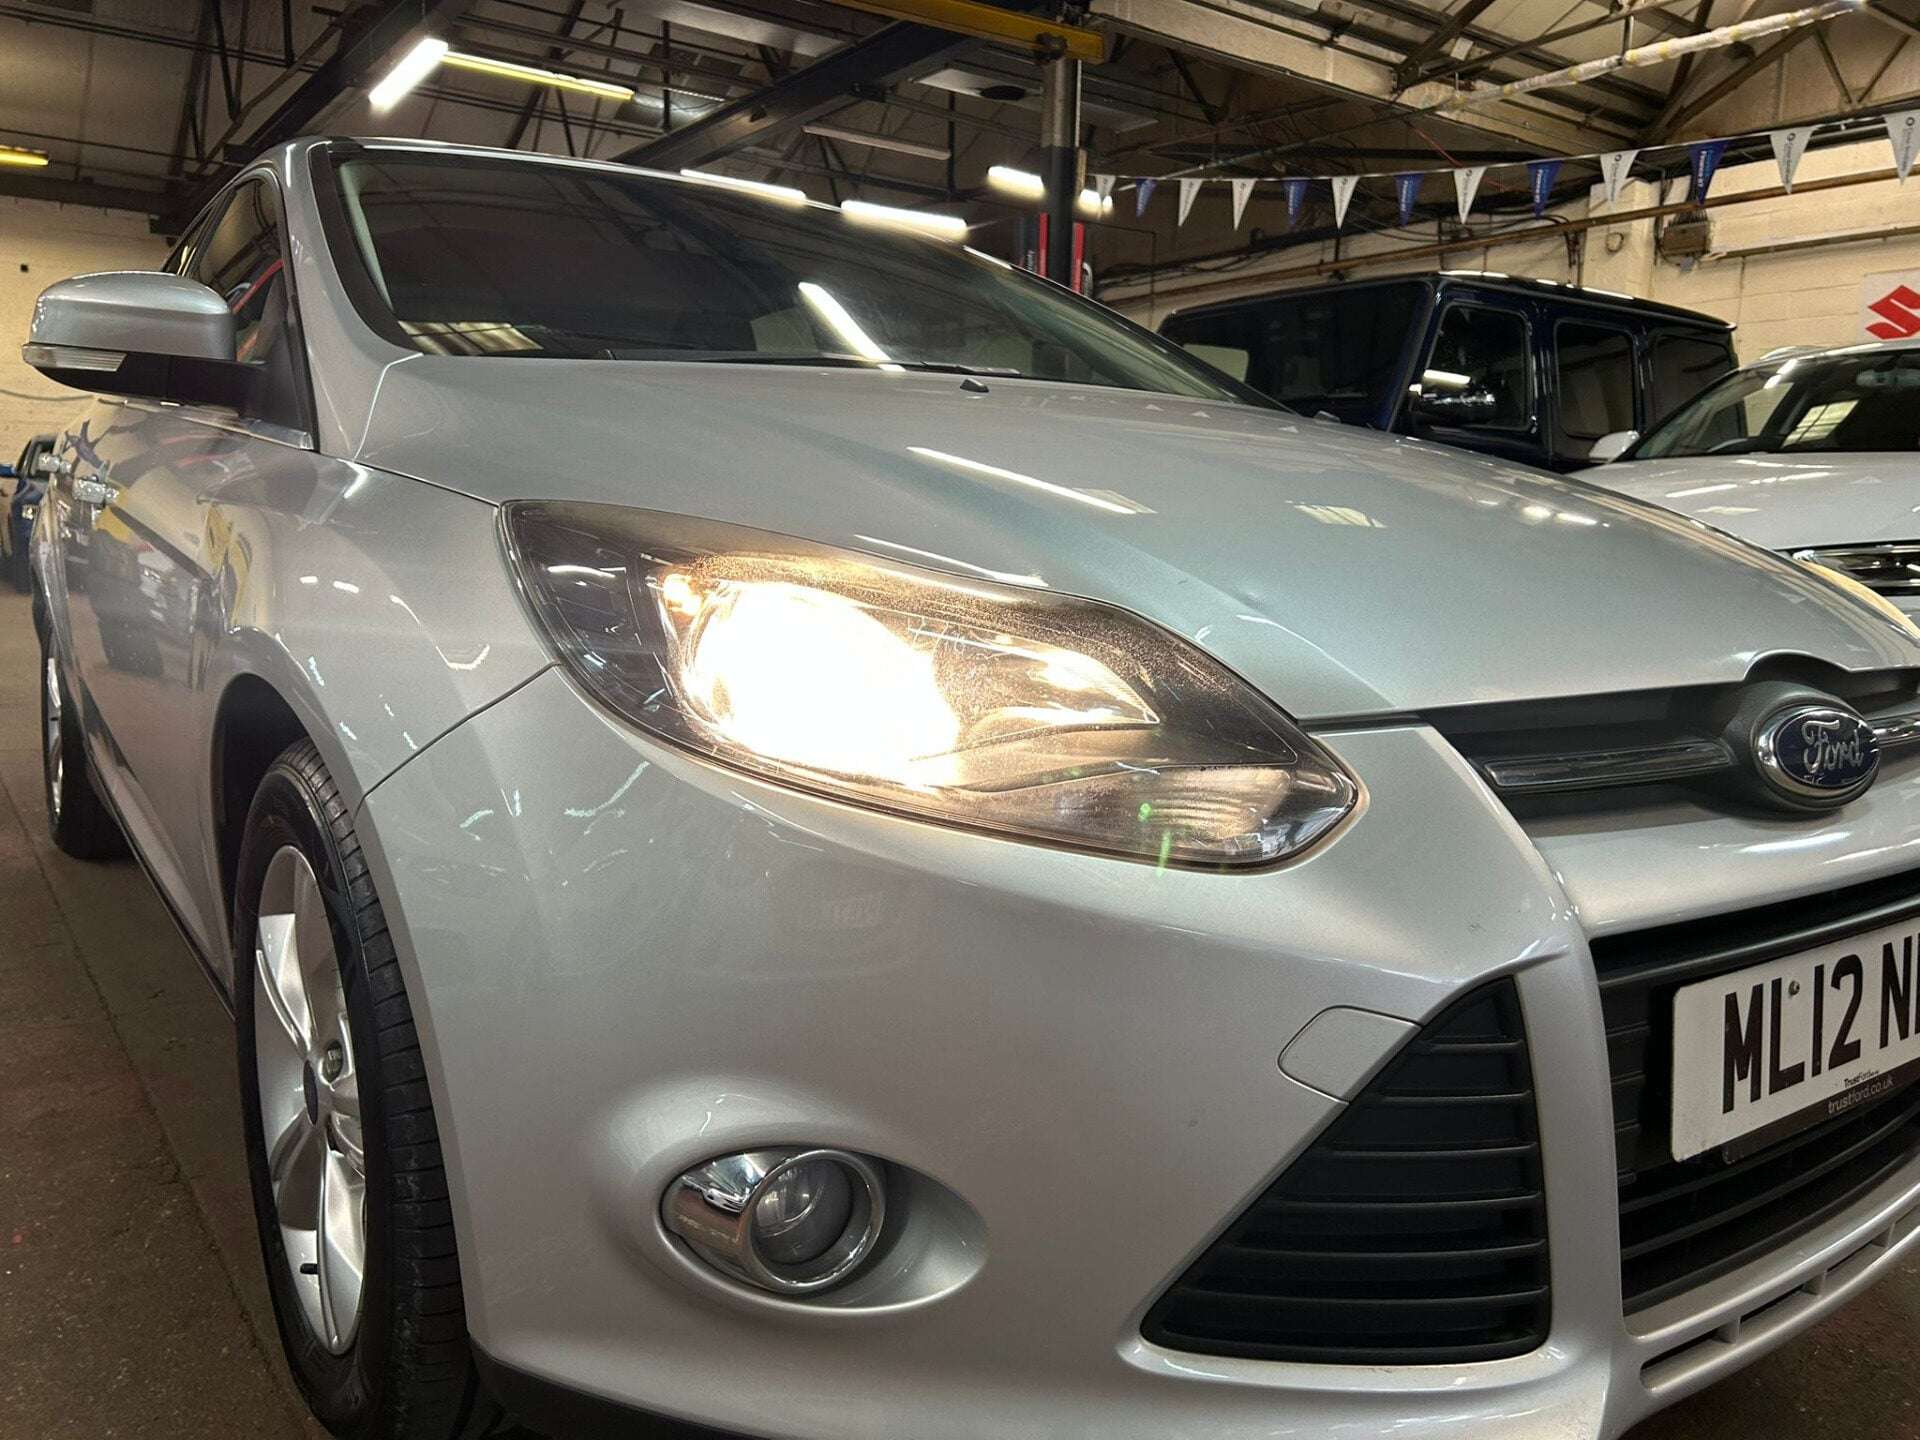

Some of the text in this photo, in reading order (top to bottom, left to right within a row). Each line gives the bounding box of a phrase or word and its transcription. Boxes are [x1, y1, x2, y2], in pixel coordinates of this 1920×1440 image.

[1801, 719, 1865, 773] Ford
[1722, 932, 1920, 1115] ML12 N
